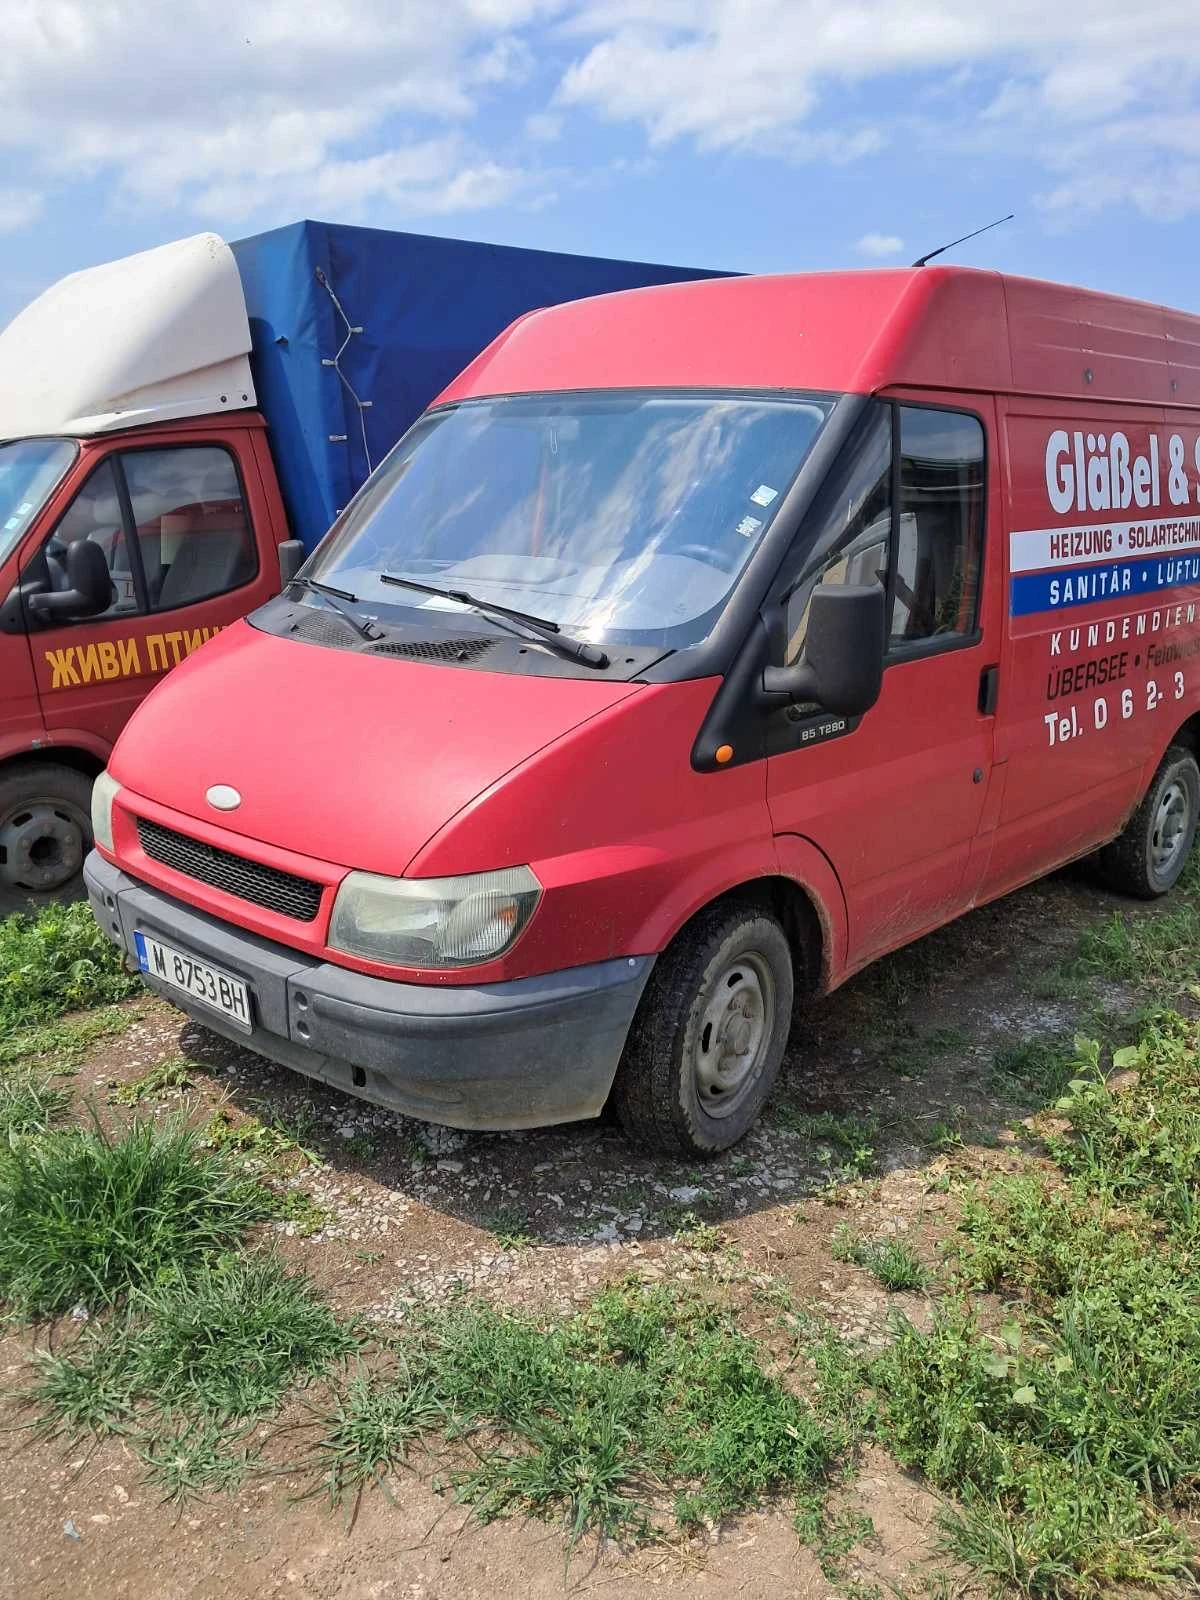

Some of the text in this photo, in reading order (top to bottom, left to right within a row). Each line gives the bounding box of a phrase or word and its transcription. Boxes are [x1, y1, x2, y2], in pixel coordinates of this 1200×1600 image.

[1046, 430, 1160, 514] Gläßel
[1168, 434, 1189, 506] &
[1050, 529, 1112, 559] HEIZUNG
[1050, 556, 1199, 605] SANITÄR LÜFTU
[1051, 604, 1200, 656] KUNDENDIEN
[45, 625, 230, 688] ЖИВИ ПТИ
[1046, 651, 1129, 701] ÜBERSEE
[819, 720, 845, 736] T280
[1044, 706, 1084, 746] Tel.
[152, 944, 167, 977] M
